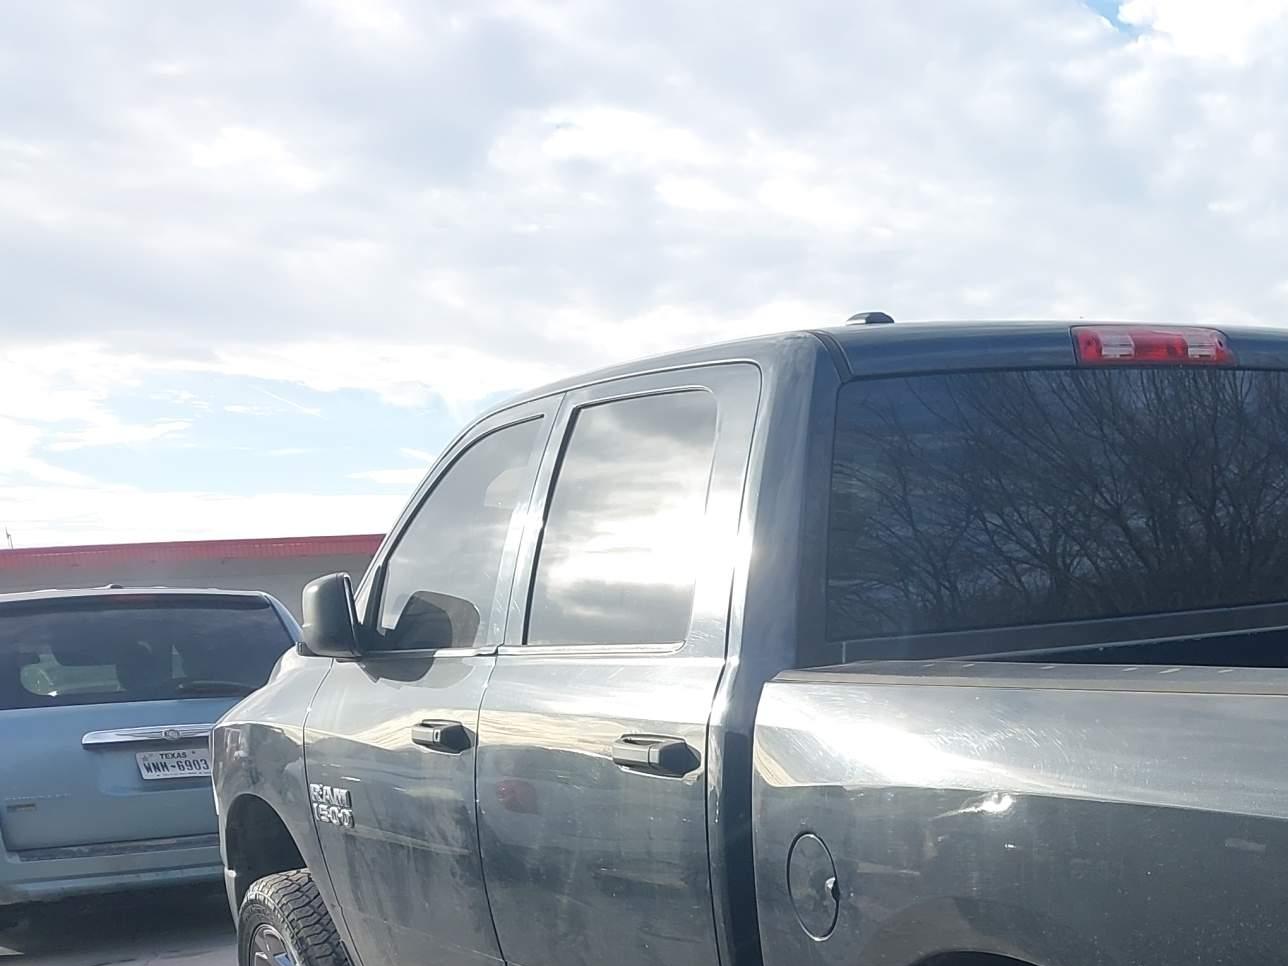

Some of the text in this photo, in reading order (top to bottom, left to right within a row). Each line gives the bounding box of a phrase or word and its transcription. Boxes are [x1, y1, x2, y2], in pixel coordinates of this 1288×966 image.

[160, 752, 187, 760] TEXAS
[310, 783, 352, 808] RAM
[312, 802, 354, 828] 1500
